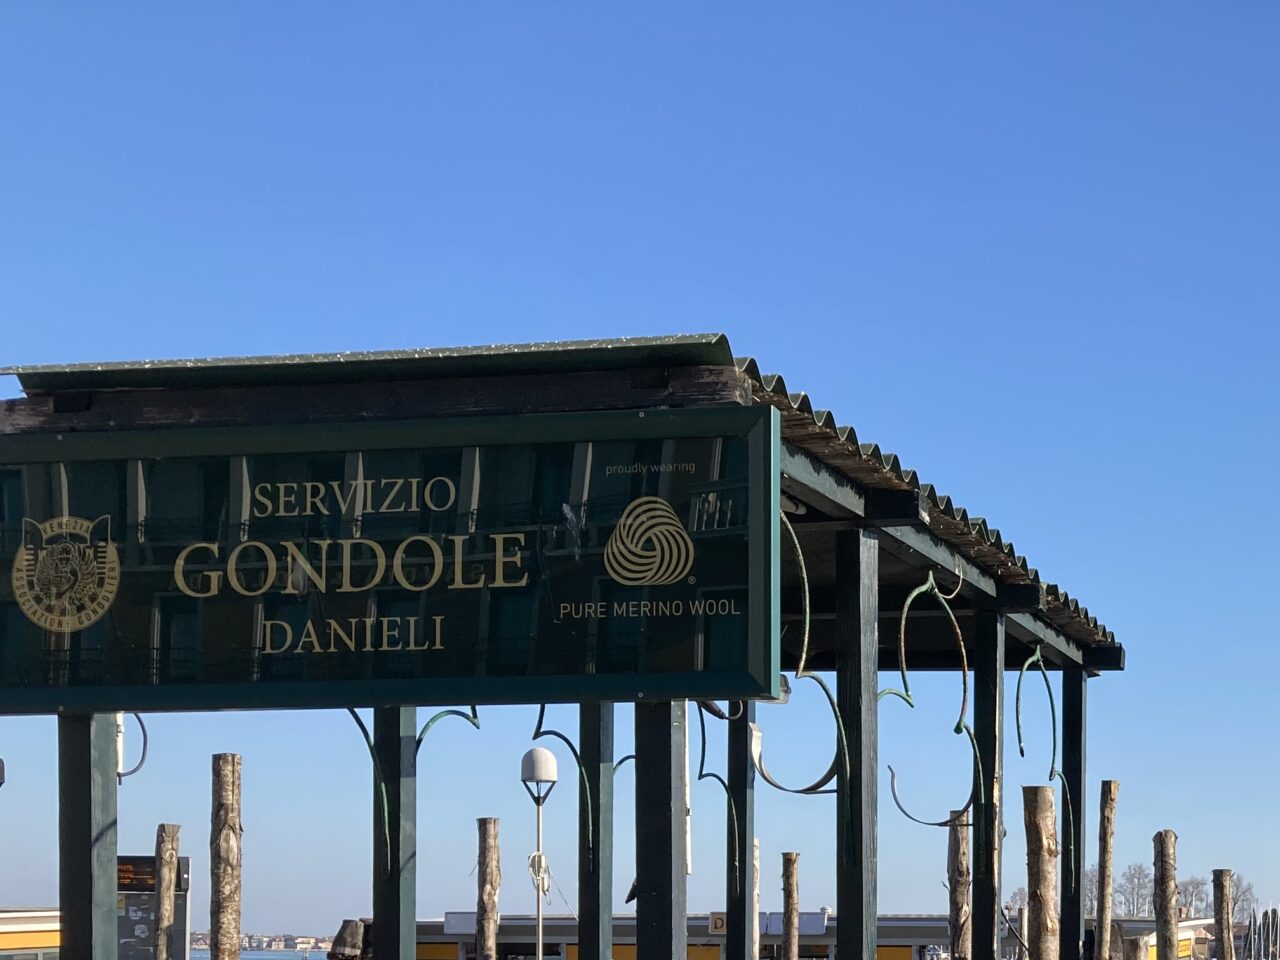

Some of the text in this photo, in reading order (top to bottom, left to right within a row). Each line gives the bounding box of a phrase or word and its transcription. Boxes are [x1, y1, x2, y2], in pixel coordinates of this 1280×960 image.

[606, 462, 696, 476] proudly wearing
[253, 476, 456, 518] SERVIZIO
[41, 520, 91, 535] VENEZIA
[174, 533, 529, 598] GONDOLE
[77, 559, 118, 626] GONDOLIERI
[560, 599, 741, 619] PURE MERINO WOOL
[261, 616, 445, 654] DANIELI
[714, 917, 725, 930] D
